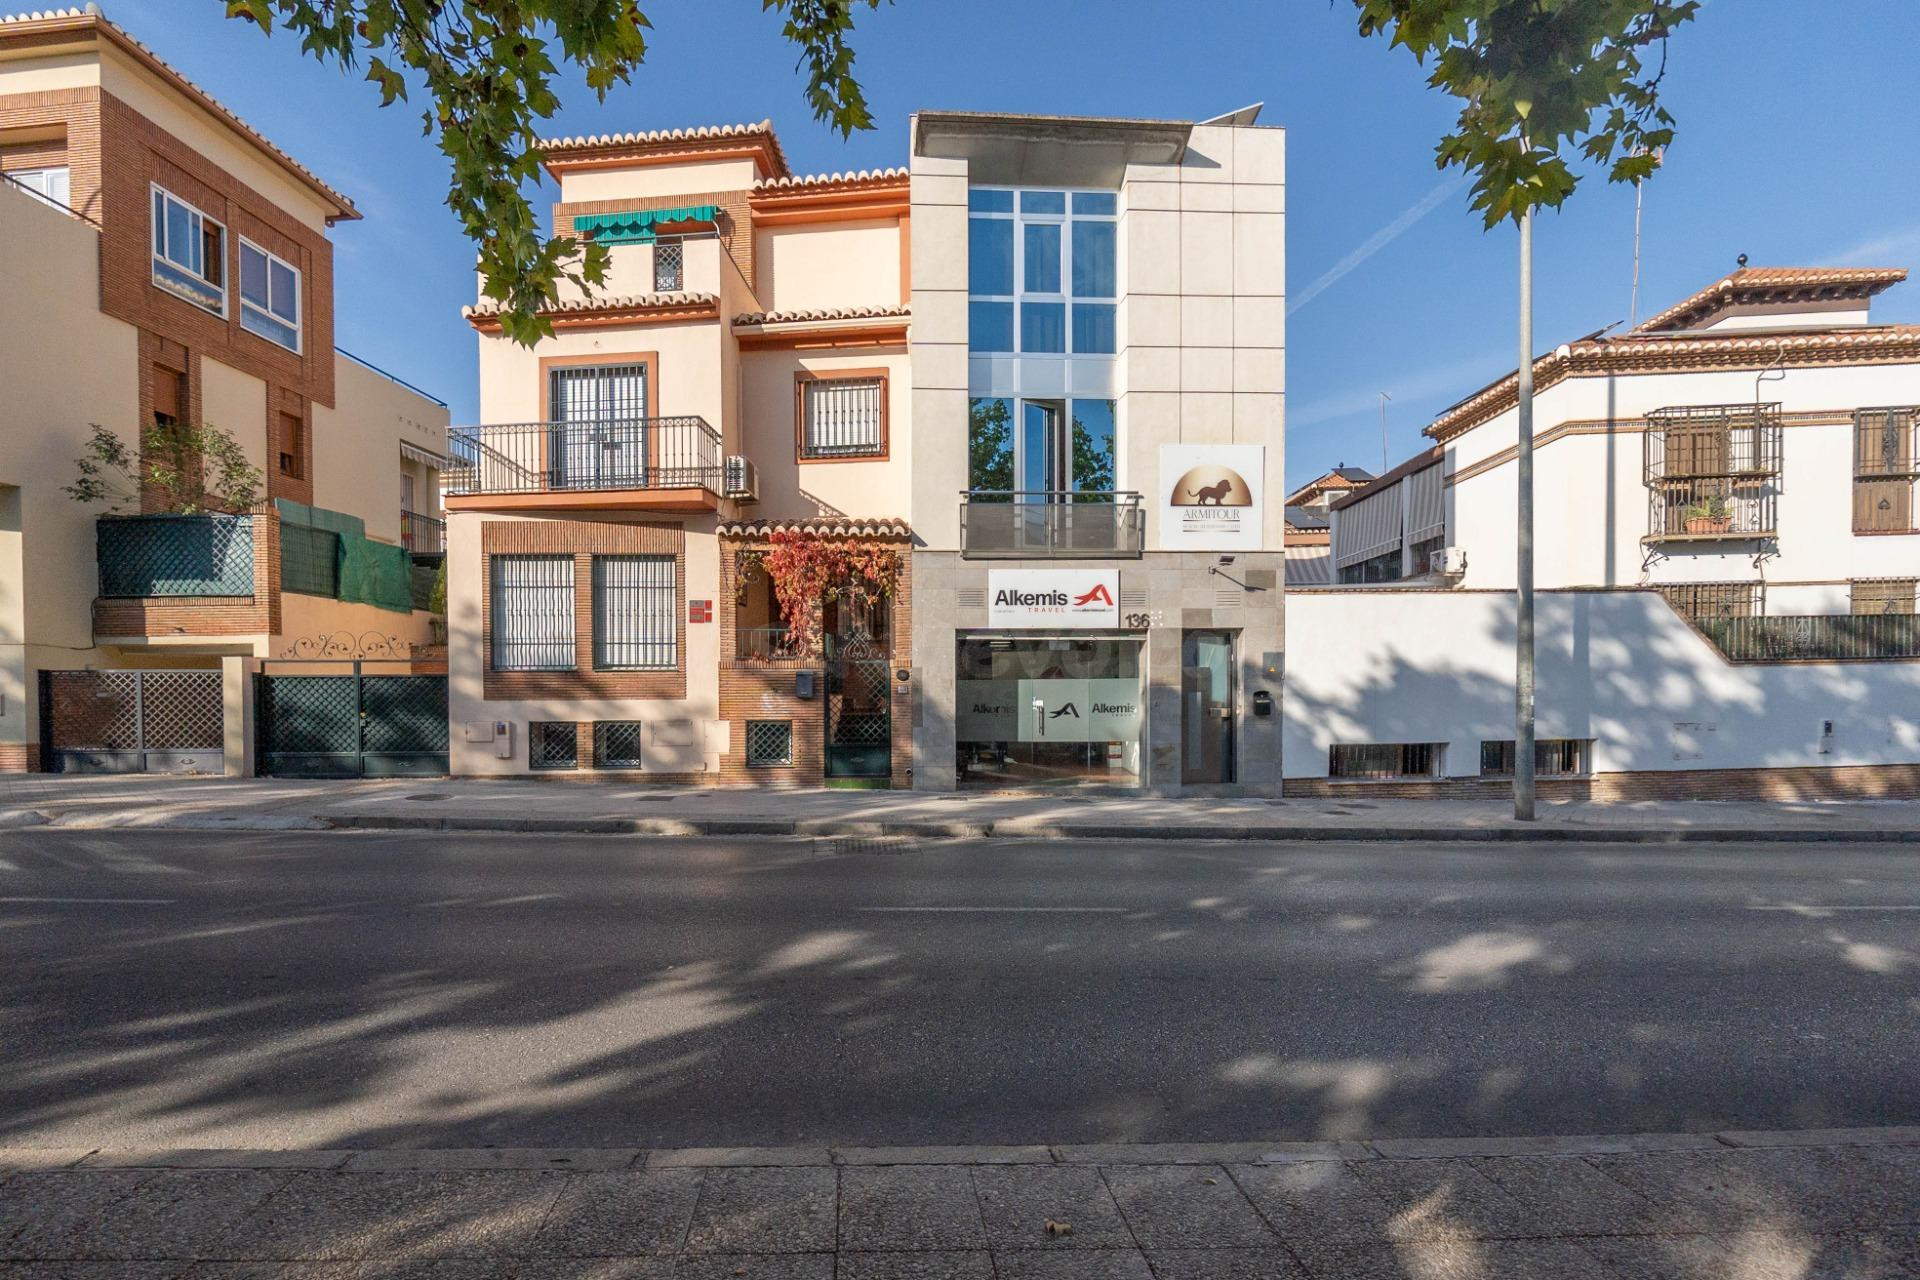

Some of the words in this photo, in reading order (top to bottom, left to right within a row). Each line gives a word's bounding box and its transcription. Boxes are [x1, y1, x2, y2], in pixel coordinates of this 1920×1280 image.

[1184, 509, 1240, 519] ARMITOUR
[995, 590, 1068, 606] Alkemis
[1125, 613, 1150, 628] 136
[1092, 703, 1136, 713] Alkemis
